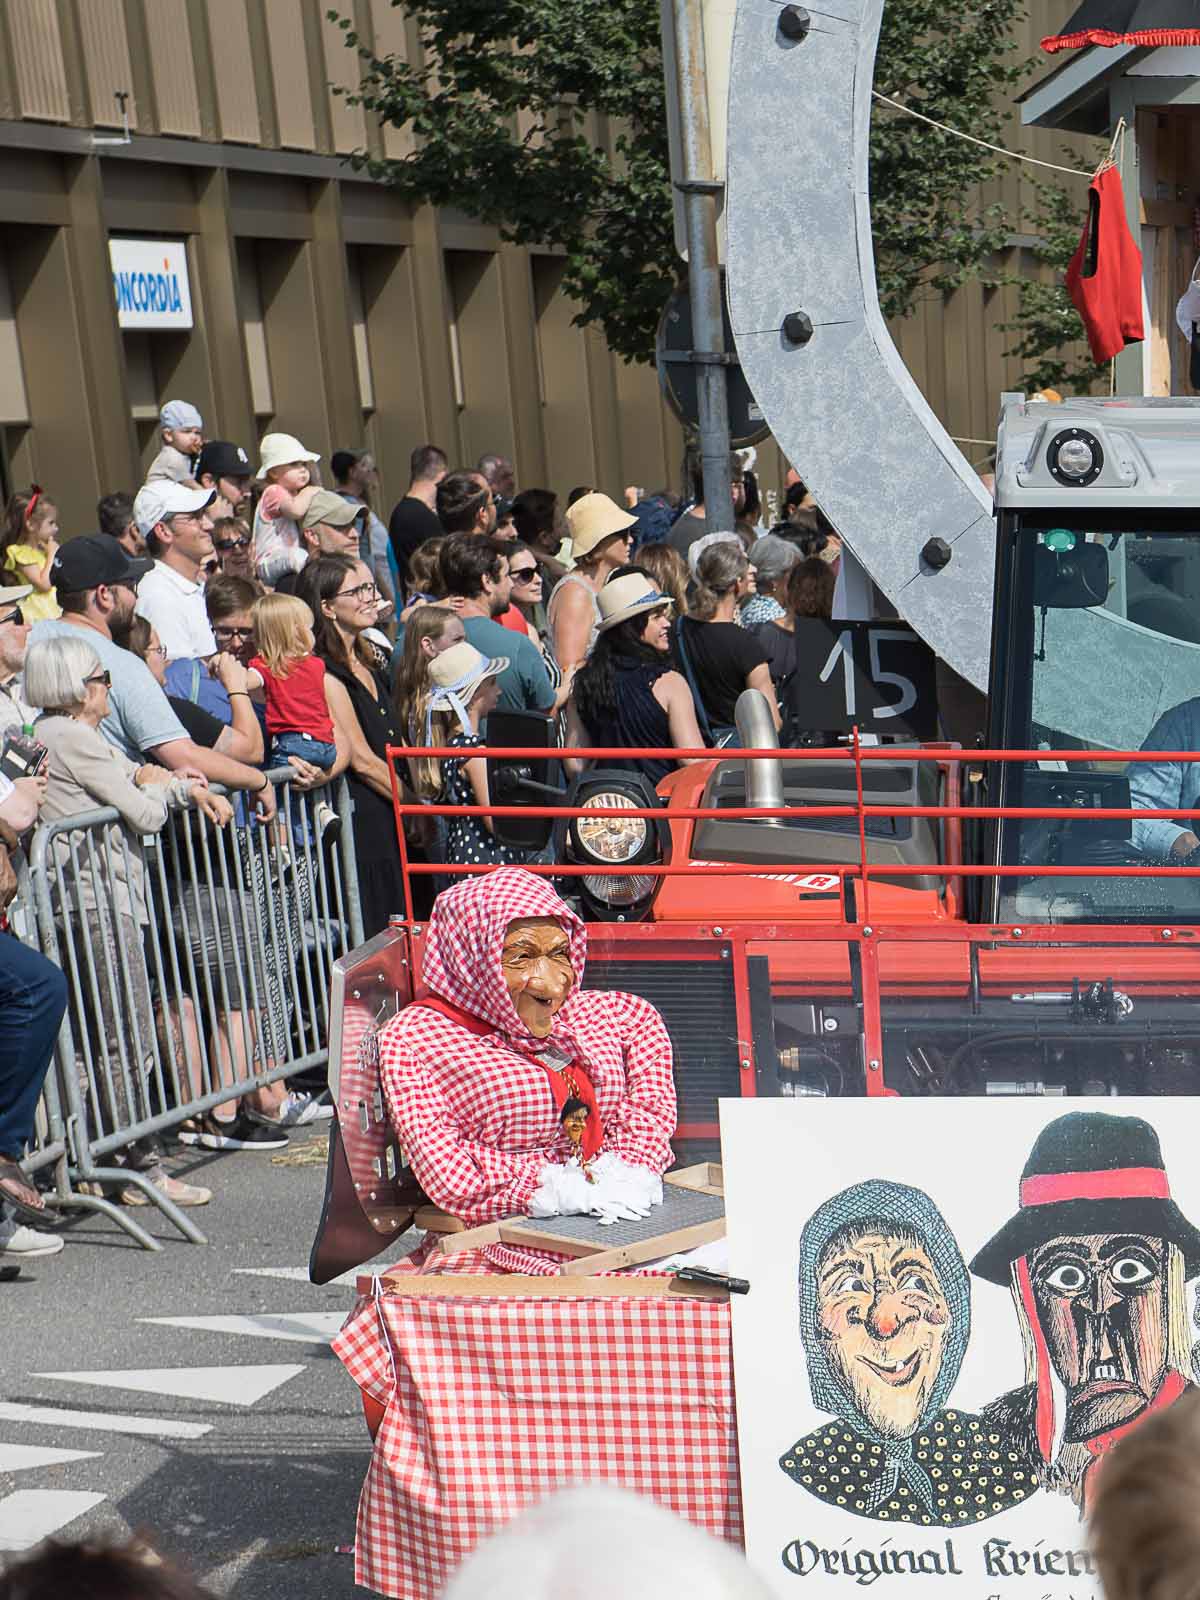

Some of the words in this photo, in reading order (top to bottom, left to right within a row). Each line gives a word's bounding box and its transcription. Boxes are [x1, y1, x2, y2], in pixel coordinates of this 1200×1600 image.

[820, 629, 920, 718] 15
[782, 1537, 964, 1587] Original
[983, 1537, 1101, 1577] Krien
